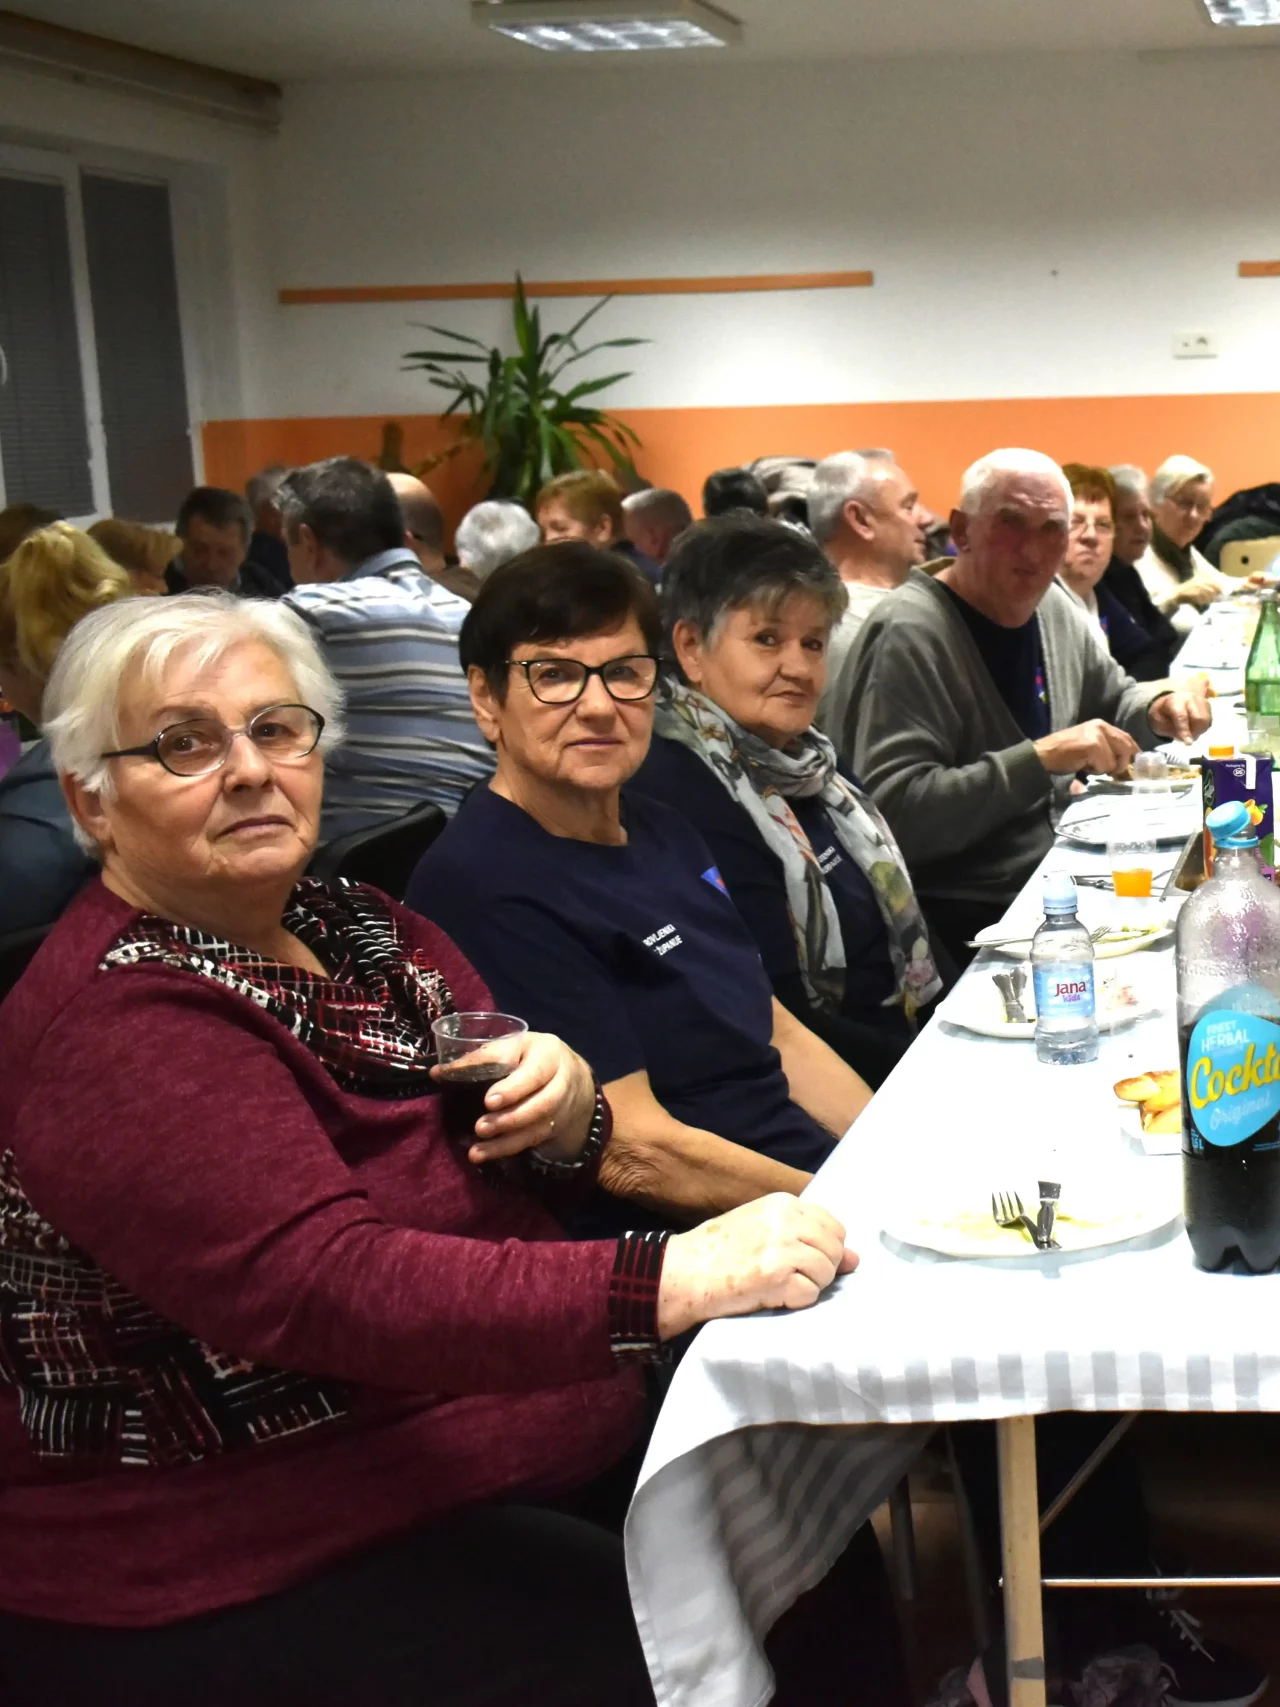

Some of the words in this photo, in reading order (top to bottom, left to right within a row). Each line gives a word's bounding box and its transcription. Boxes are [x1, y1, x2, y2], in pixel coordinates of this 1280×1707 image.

[1207, 1020, 1236, 1035] FINEST
[1202, 1029, 1250, 1052] HERBAL
[1210, 1090, 1270, 1130] Original
